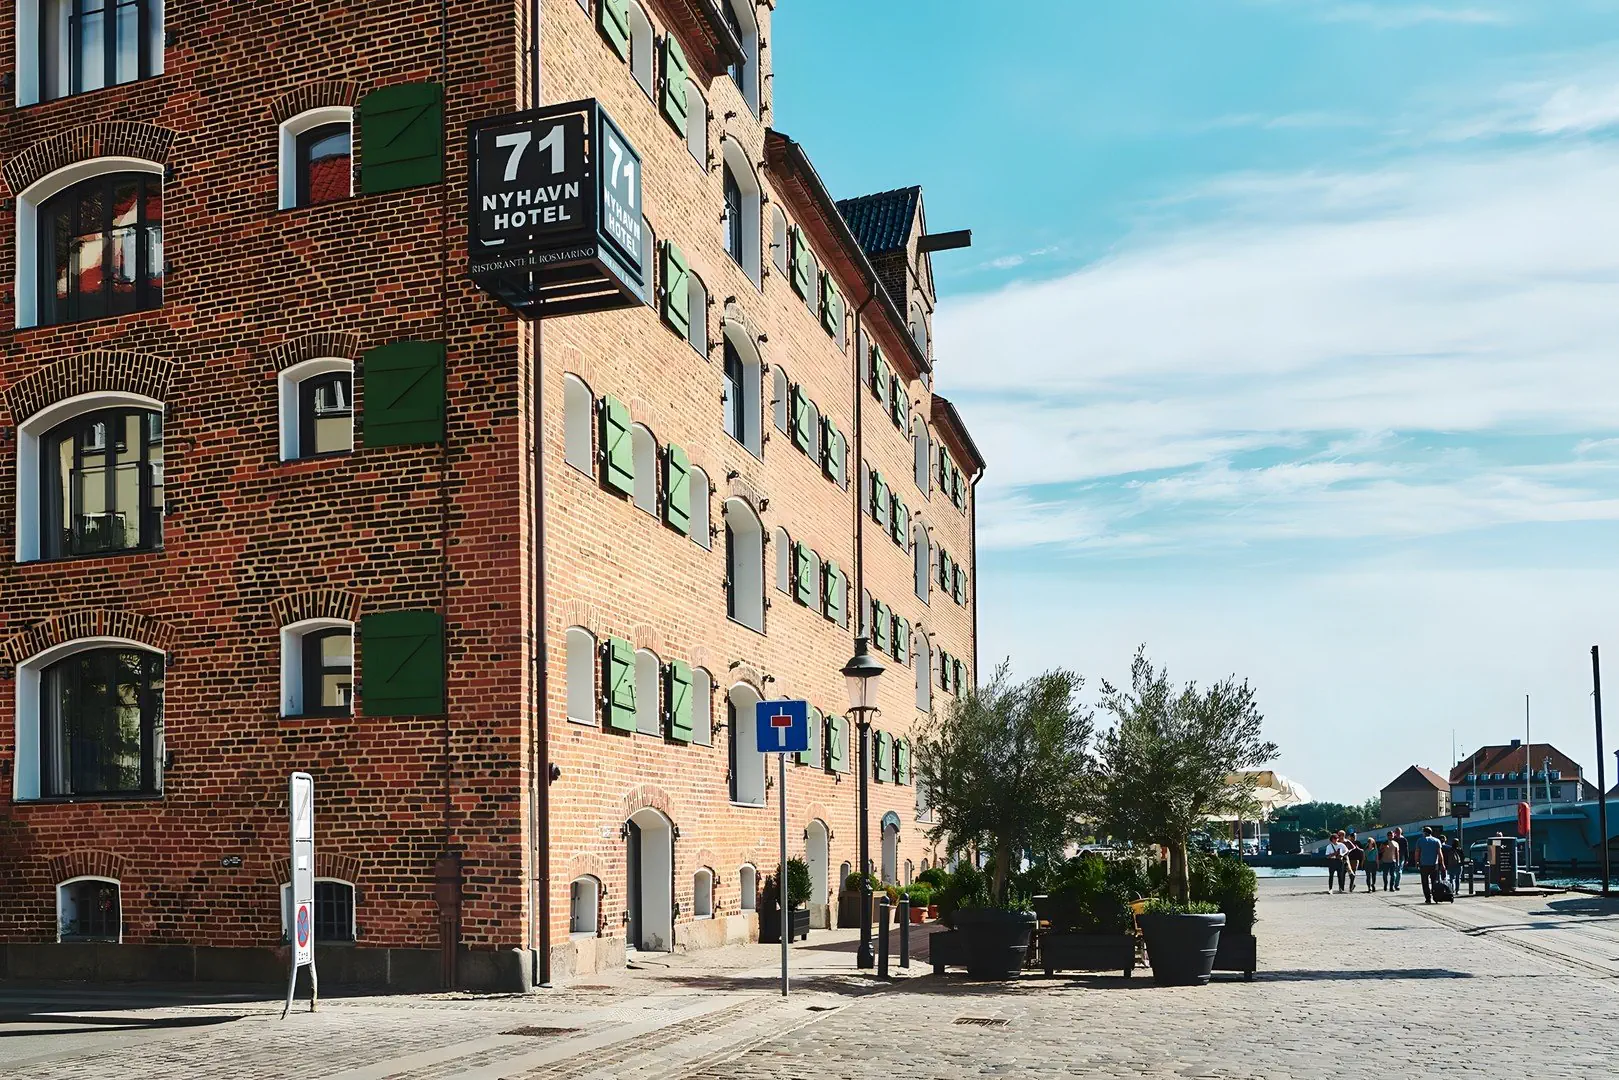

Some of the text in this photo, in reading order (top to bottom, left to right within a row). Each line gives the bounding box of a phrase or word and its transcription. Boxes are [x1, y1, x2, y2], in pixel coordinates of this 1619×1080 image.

[496, 125, 565, 181] 71
[608, 135, 635, 209] 71
[482, 181, 579, 211] NYHAVN
[494, 205, 571, 230] HOTEL
[604, 185, 640, 241] NYHAVN
[608, 212, 638, 257] HOTEL
[472, 247, 594, 274] RISTORANTE IL ROSMARINO
